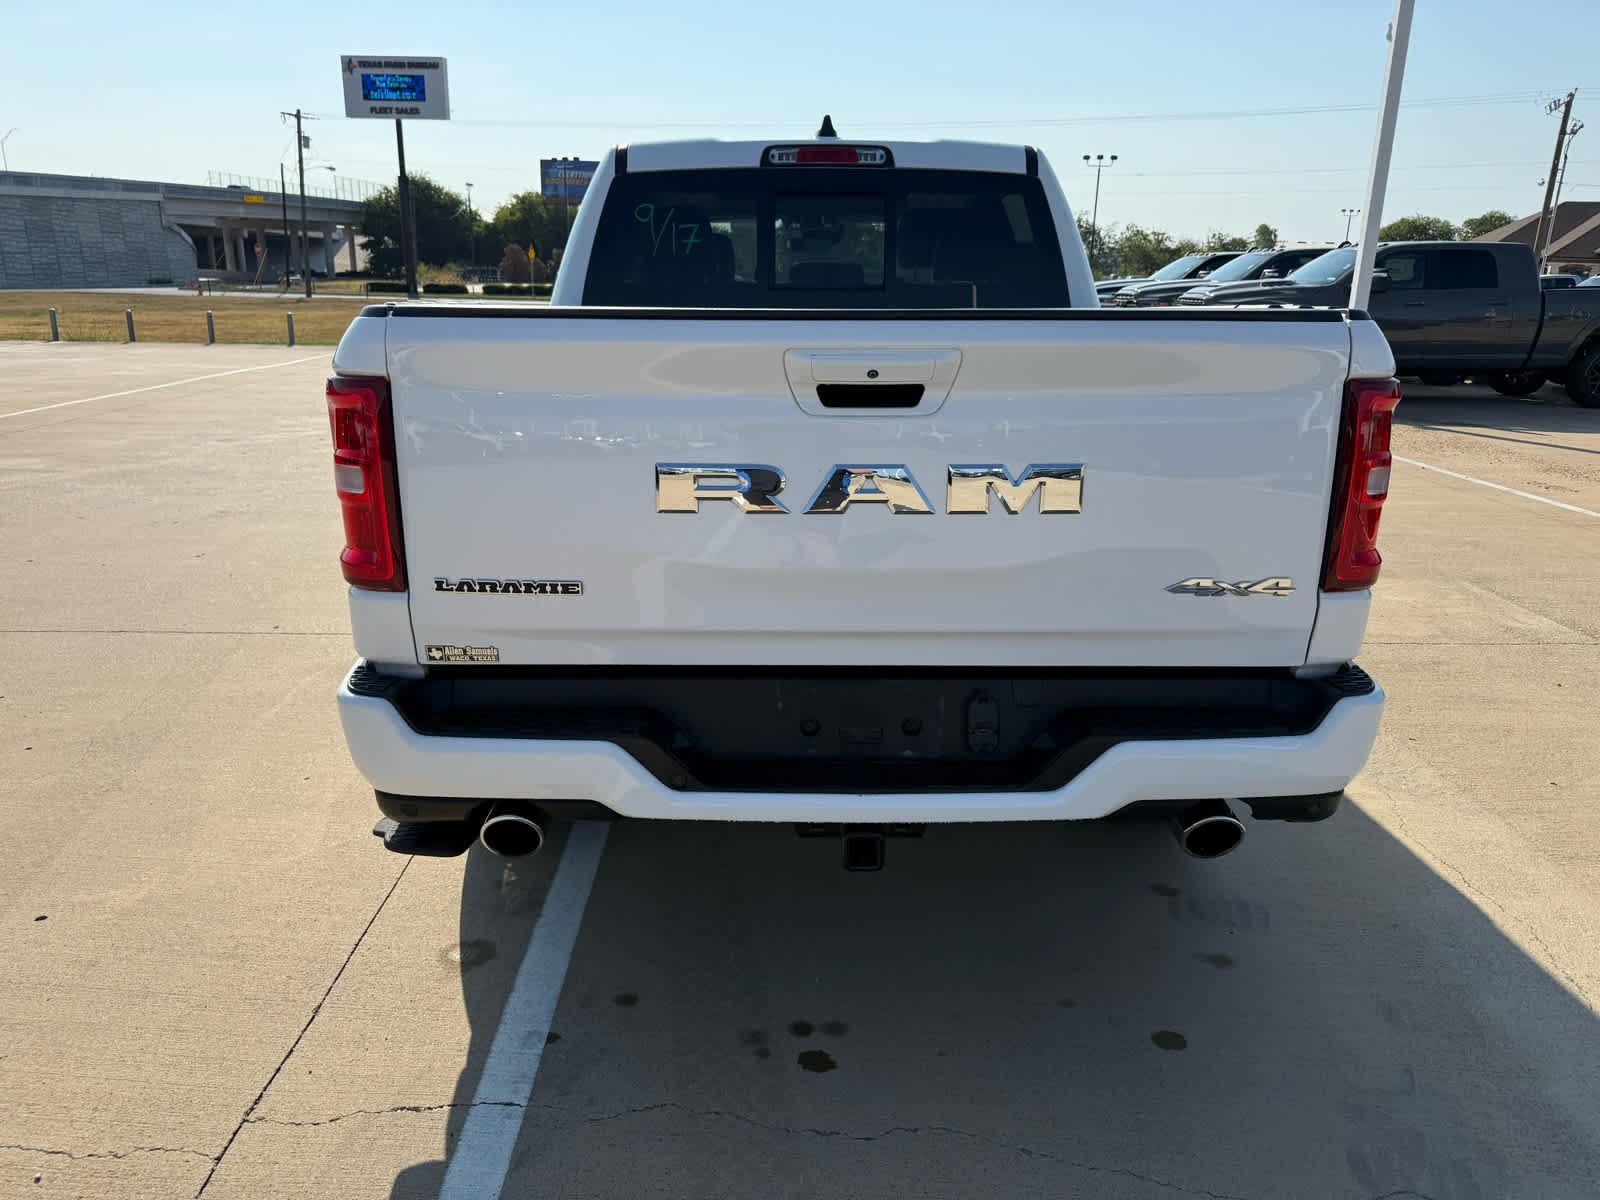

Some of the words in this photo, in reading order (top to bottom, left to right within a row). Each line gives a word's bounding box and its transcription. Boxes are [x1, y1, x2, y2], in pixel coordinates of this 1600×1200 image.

[370, 107, 393, 115] FLEET
[395, 107, 421, 115] SALES
[634, 203, 702, 257] 9/17
[656, 463, 1086, 514] RAM
[434, 577, 583, 595] LARAMIE
[445, 646, 464, 655] Allen
[465, 646, 498, 655] Samuels
